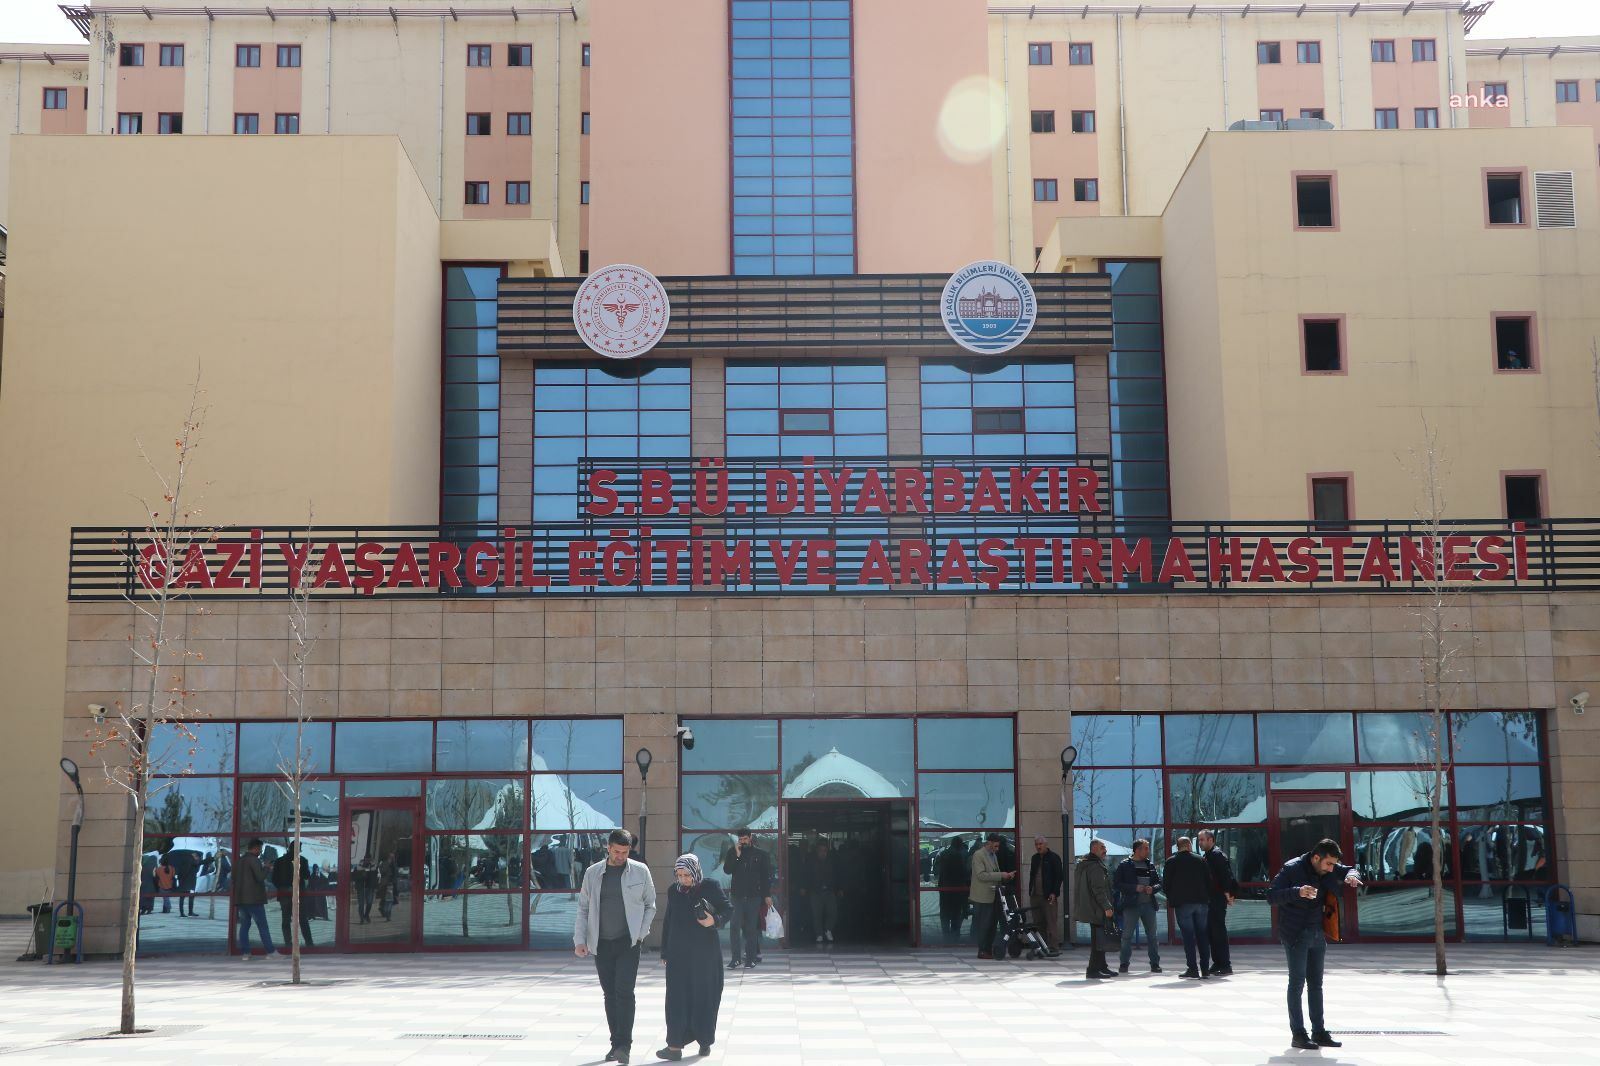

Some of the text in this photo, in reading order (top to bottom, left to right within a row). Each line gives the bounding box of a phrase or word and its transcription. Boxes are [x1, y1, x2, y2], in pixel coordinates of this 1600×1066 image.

[956, 264, 997, 285] BİLİMLERİ
[999, 266, 1034, 317] ÜNİVERSİTESİ
[586, 456, 1101, 515] S.B.Ü. DİYARBAKIR
[138, 521, 1529, 595] GAZİ YAŞARGİL EĞİTİM VE ARAŞTIRMA HASTANESİ
